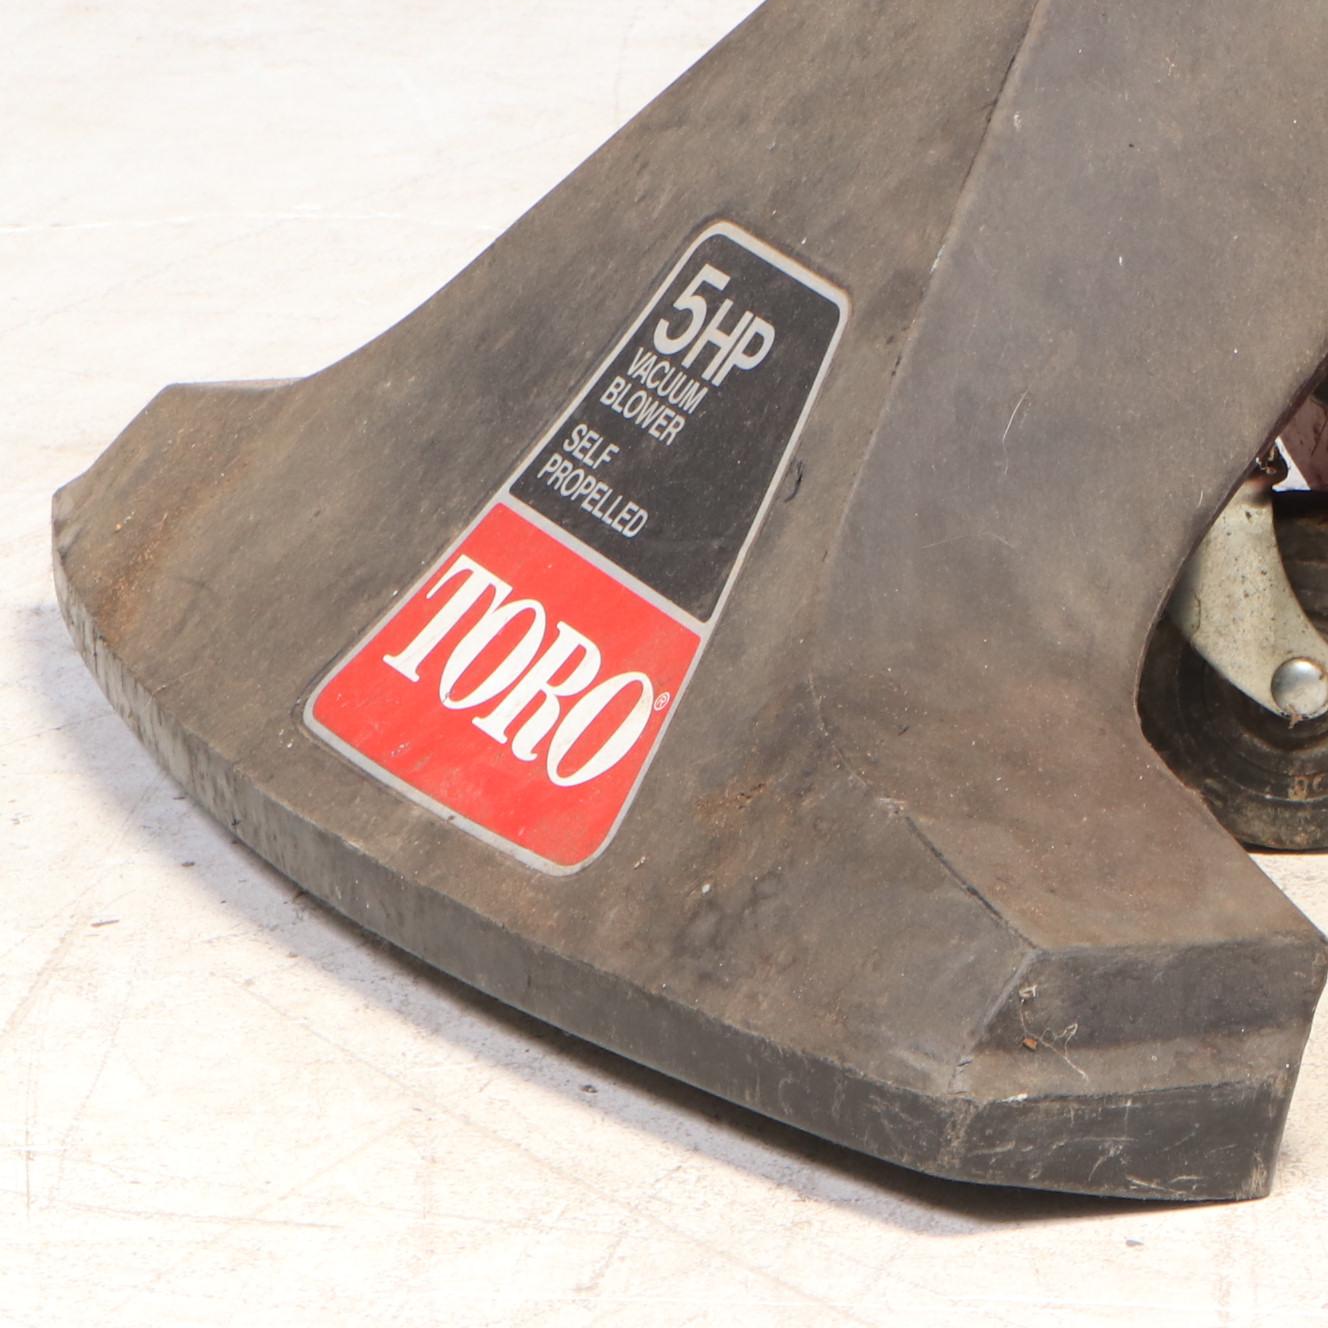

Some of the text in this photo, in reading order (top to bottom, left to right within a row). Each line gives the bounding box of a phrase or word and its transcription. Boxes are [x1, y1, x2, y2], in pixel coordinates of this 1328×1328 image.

[599, 380, 687, 447] BLOWER
[626, 346, 709, 414] VACUUM
[561, 422, 620, 468] SELF
[537, 451, 647, 539] PROPELLED
